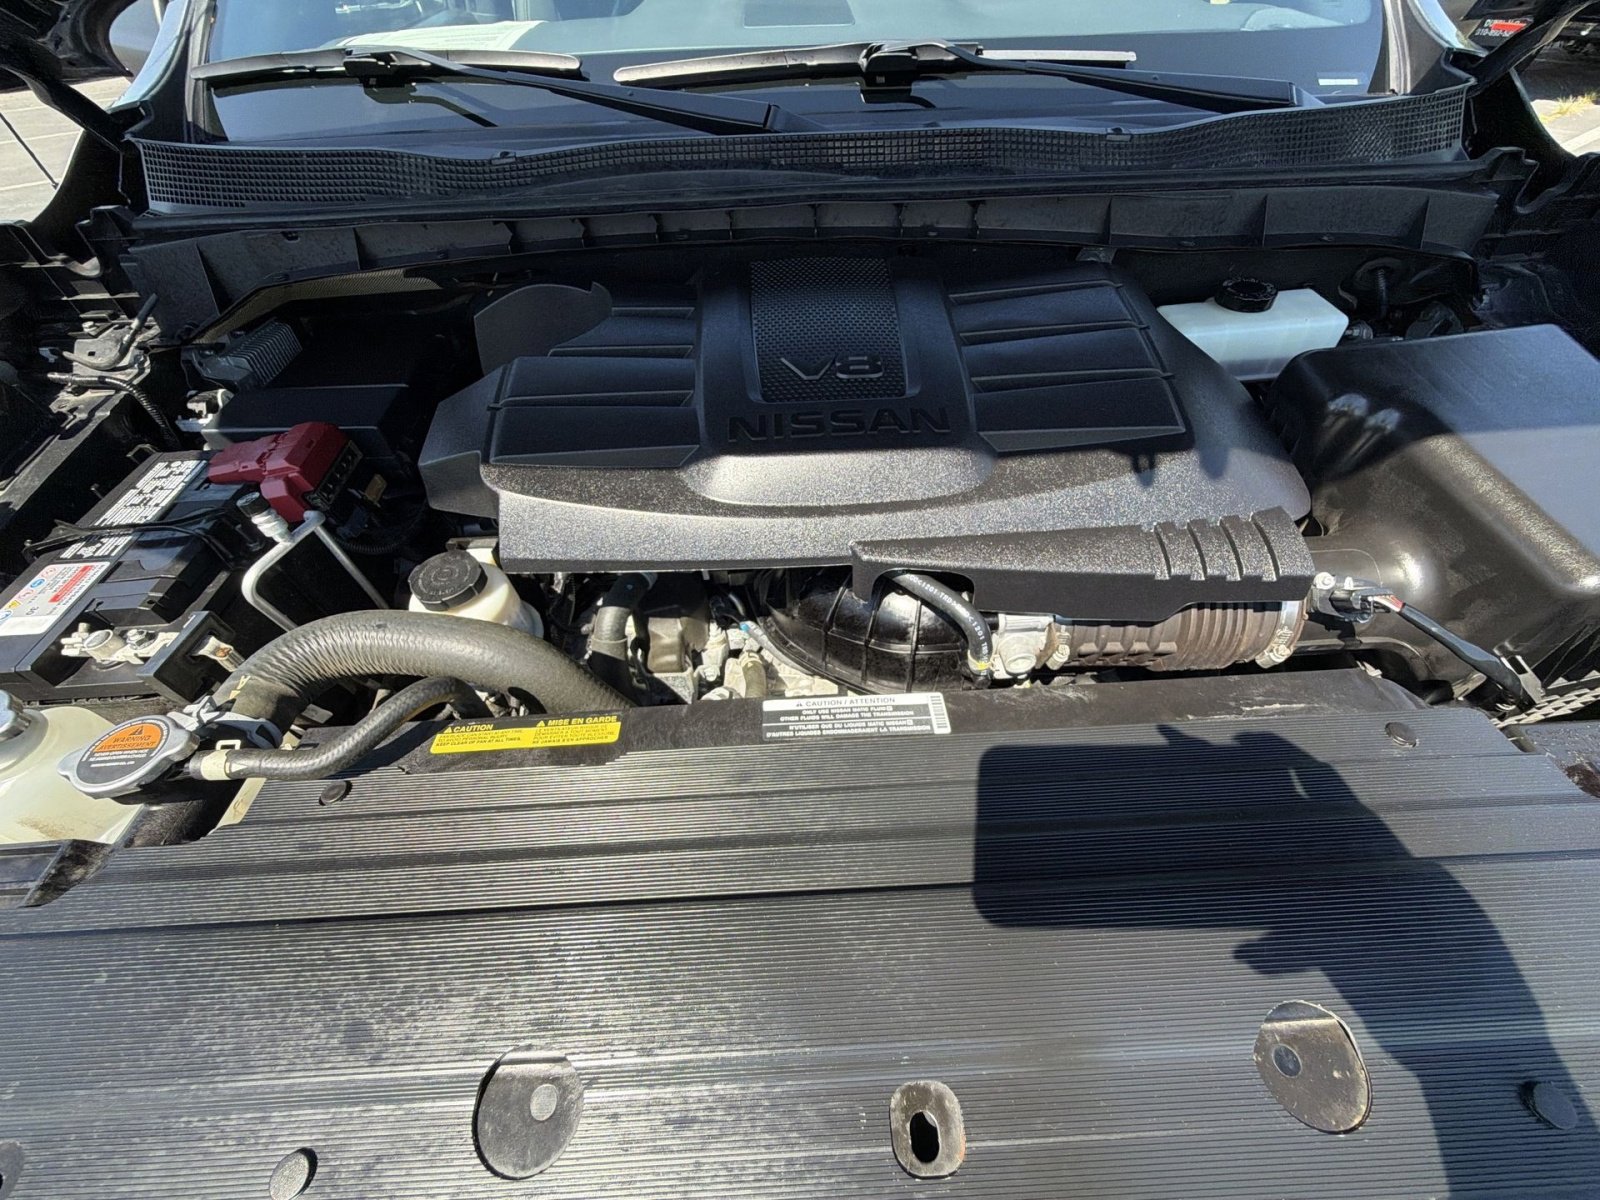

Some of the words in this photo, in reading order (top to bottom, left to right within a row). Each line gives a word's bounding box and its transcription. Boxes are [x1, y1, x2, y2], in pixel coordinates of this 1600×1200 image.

[779, 350, 884, 380] V8
[727, 407, 952, 443] NISSAN
[805, 699, 841, 707] CAUTION
[849, 697, 895, 705] ATTENTION
[547, 718, 570, 726] MISE
[571, 717, 585, 725] EN
[585, 715, 618, 724] GARDE
[453, 724, 494, 733] CAUTION
[113, 735, 152, 744] WARNING
